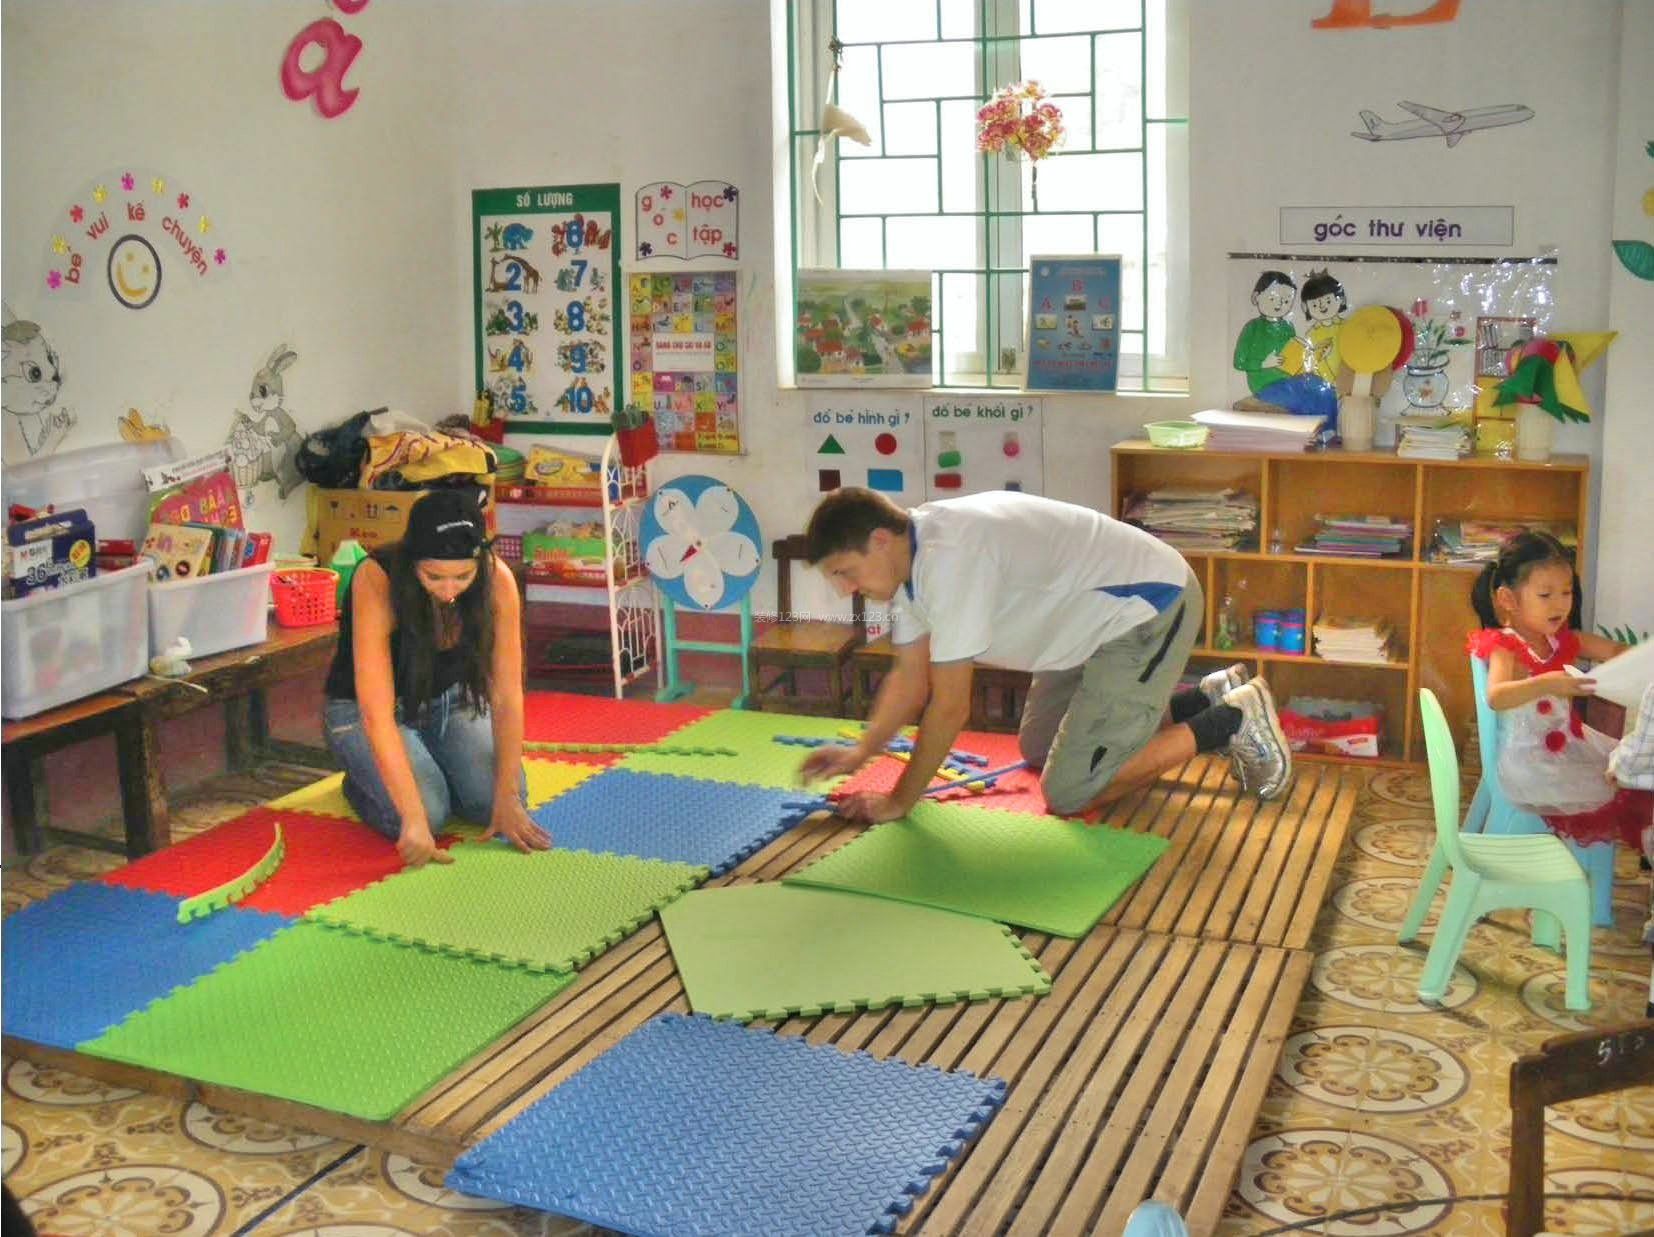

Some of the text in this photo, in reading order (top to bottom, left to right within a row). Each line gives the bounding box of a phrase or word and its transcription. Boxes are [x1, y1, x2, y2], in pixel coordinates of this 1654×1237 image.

[691, 191, 724, 213] học
[692, 223, 723, 245] tập
[1313, 213, 1462, 242] góc thư viện
[86, 212, 111, 241] vui
[161, 215, 208, 275] chuyện
[505, 259, 588, 291] 2 7
[506, 300, 585, 332] 3 8
[508, 344, 587, 373] 4 9
[511, 383, 593, 413] 5 10
